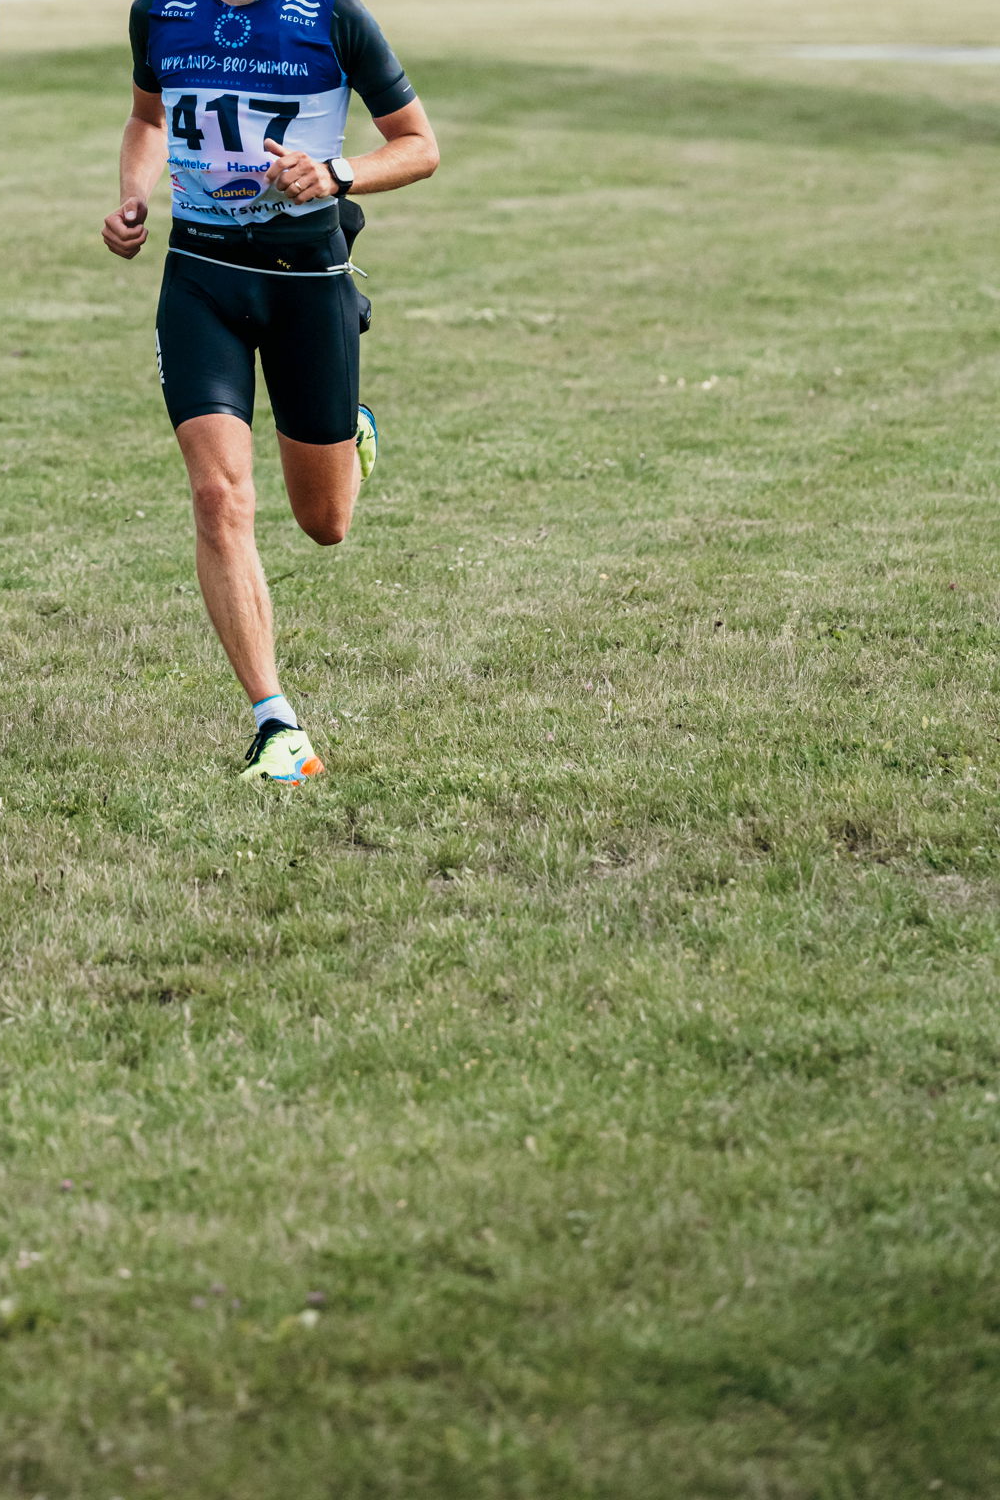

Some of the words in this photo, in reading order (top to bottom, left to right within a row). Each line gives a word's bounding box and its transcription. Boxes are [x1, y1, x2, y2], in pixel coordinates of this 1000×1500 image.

[280, 13, 317, 28] MEDLEY
[161, 54, 247, 74] UPPLANDS-BRO
[249, 59, 310, 77] SWIMRUN
[172, 93, 300, 153] 417
